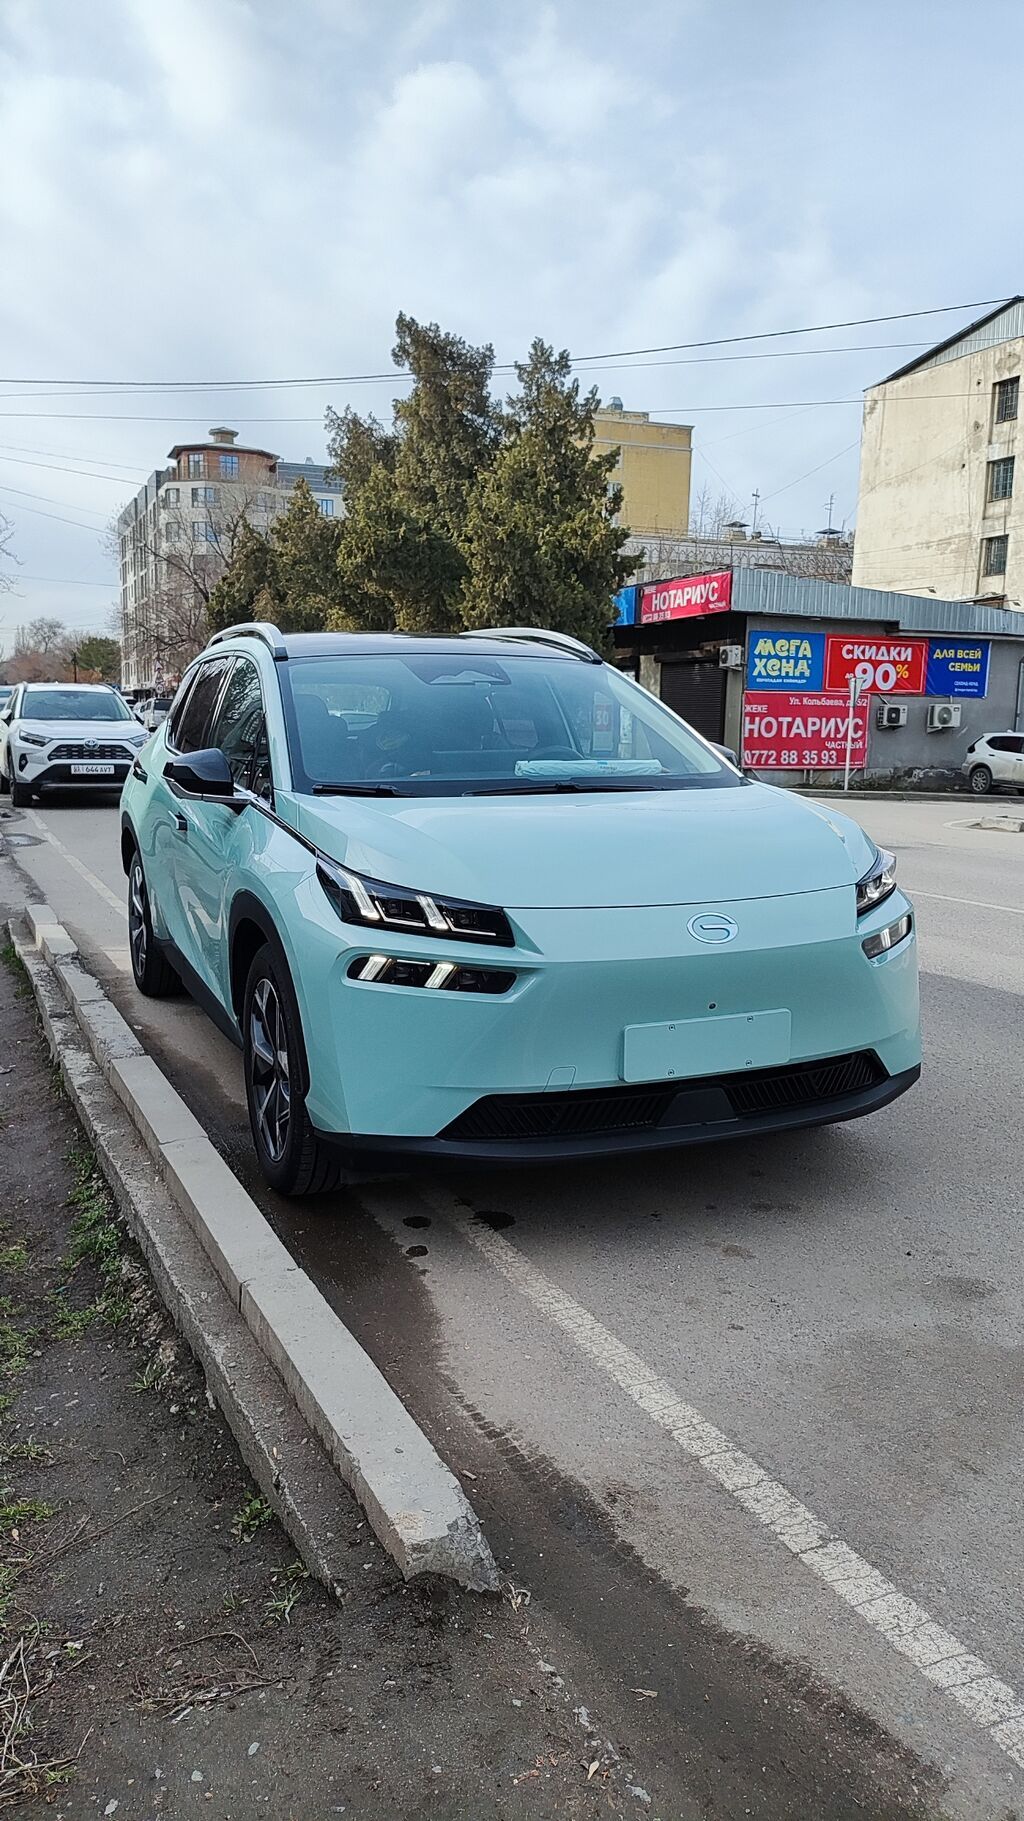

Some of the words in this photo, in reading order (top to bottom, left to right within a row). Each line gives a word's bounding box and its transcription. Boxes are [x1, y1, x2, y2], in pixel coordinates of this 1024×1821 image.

[651, 581, 719, 611] НОТАРИУС
[842, 644, 912, 661] СКИДКИ
[933, 648, 955, 659] ДЛЯ
[957, 648, 981, 659] ВСЕЙ
[948, 662, 981, 672] СЕМЬИ
[789, 696, 801, 706] Ул.
[745, 705, 769, 713] ЖЕКЕ
[744, 716, 864, 738] НОТАРИУС
[744, 750, 777, 764] 0772
[780, 750, 798, 764] 88
[802, 750, 818, 764] 35
[821, 750, 837, 764] 93
